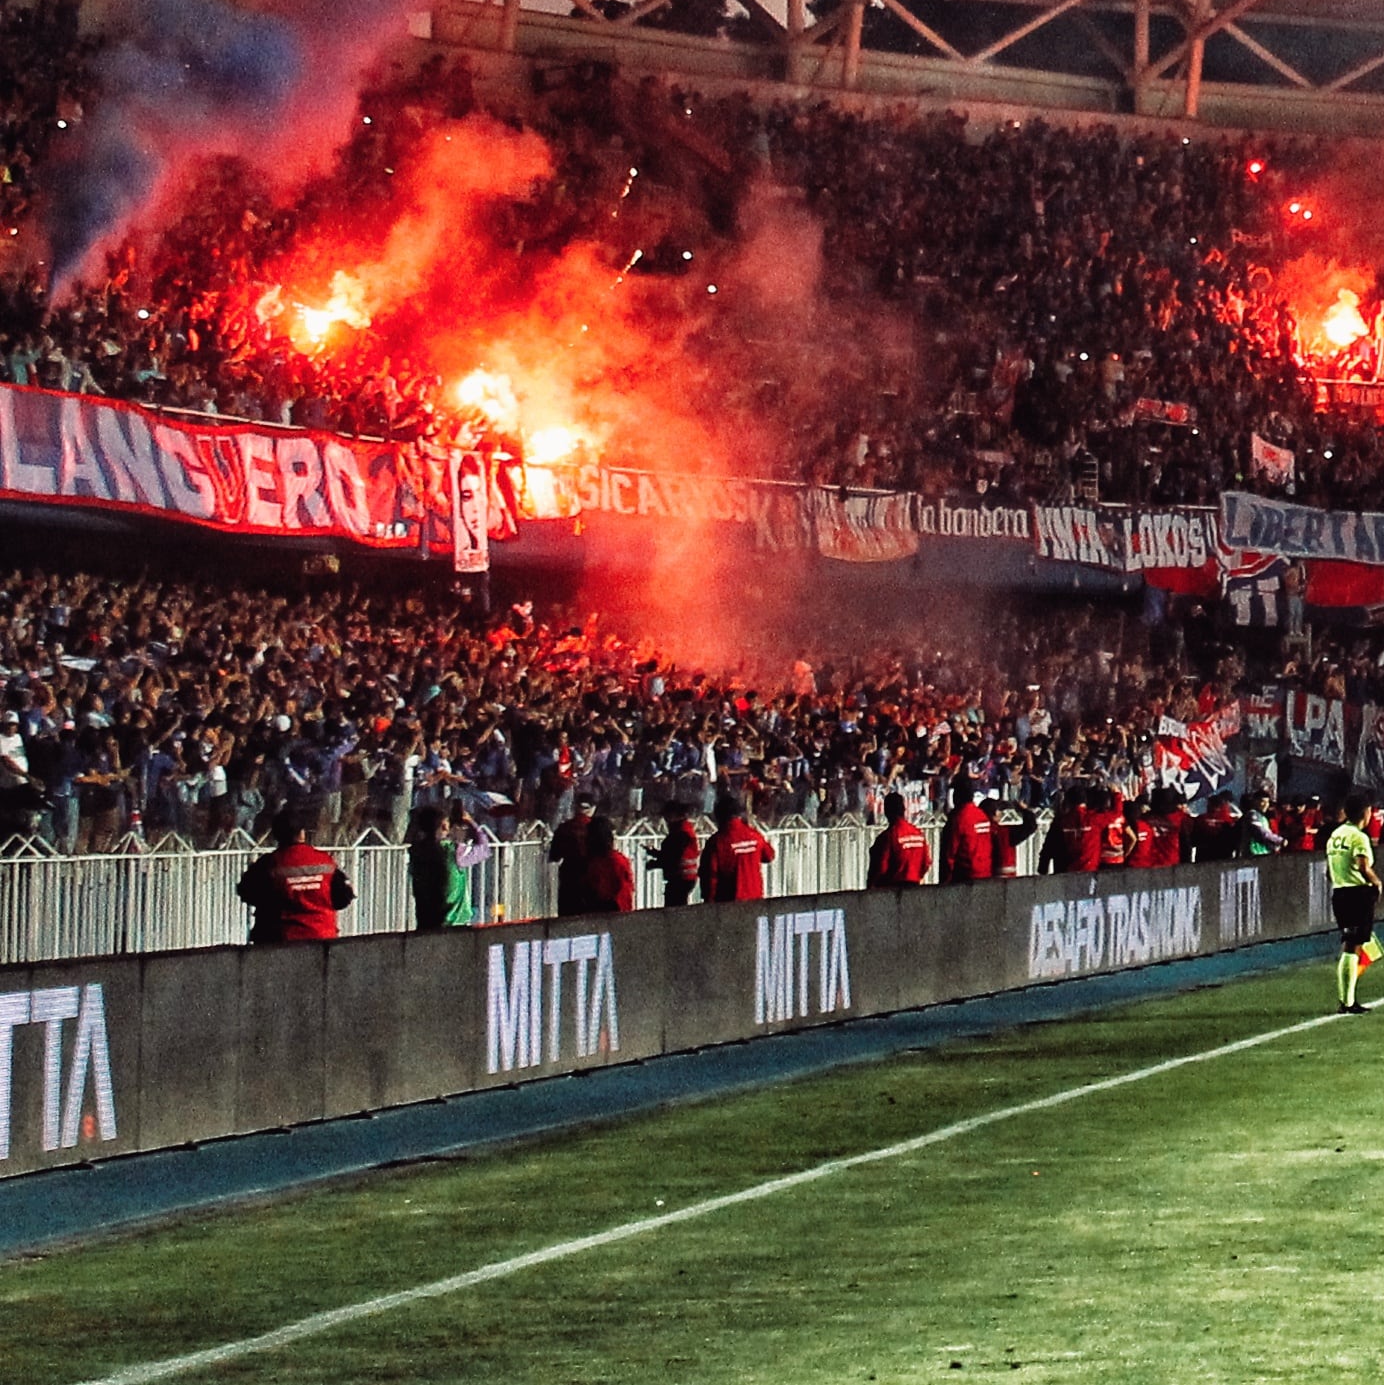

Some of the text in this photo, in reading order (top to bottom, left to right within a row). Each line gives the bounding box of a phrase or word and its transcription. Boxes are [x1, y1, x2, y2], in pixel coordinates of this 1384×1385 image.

[1124, 512, 1207, 571] LOKOS
[487, 931, 619, 1075] MITTA
[756, 908, 851, 1025] MITTA
